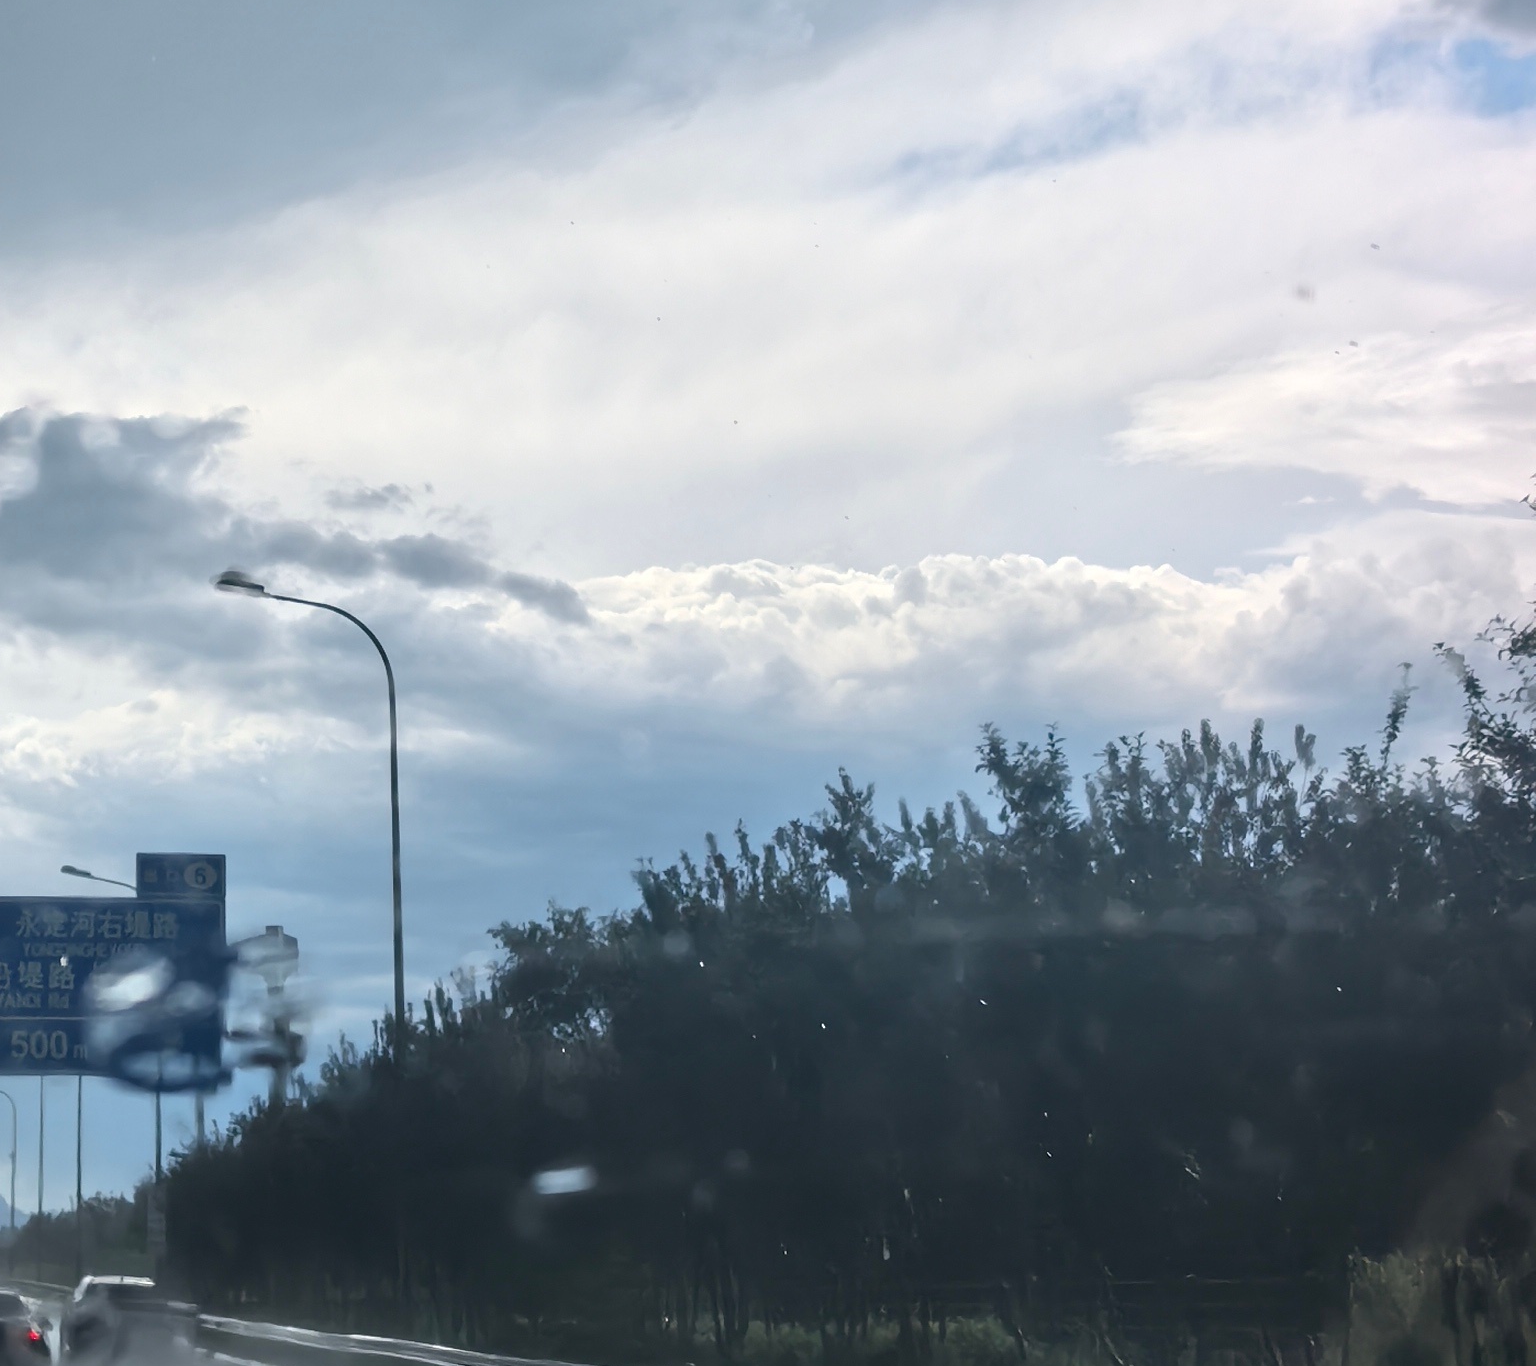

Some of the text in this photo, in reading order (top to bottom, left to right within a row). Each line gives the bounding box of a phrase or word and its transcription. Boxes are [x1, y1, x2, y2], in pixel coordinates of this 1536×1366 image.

[194, 867, 207, 885] 6
[16, 909, 178, 940] 永定河右堤路
[11, 1030, 89, 1060] 500 m
